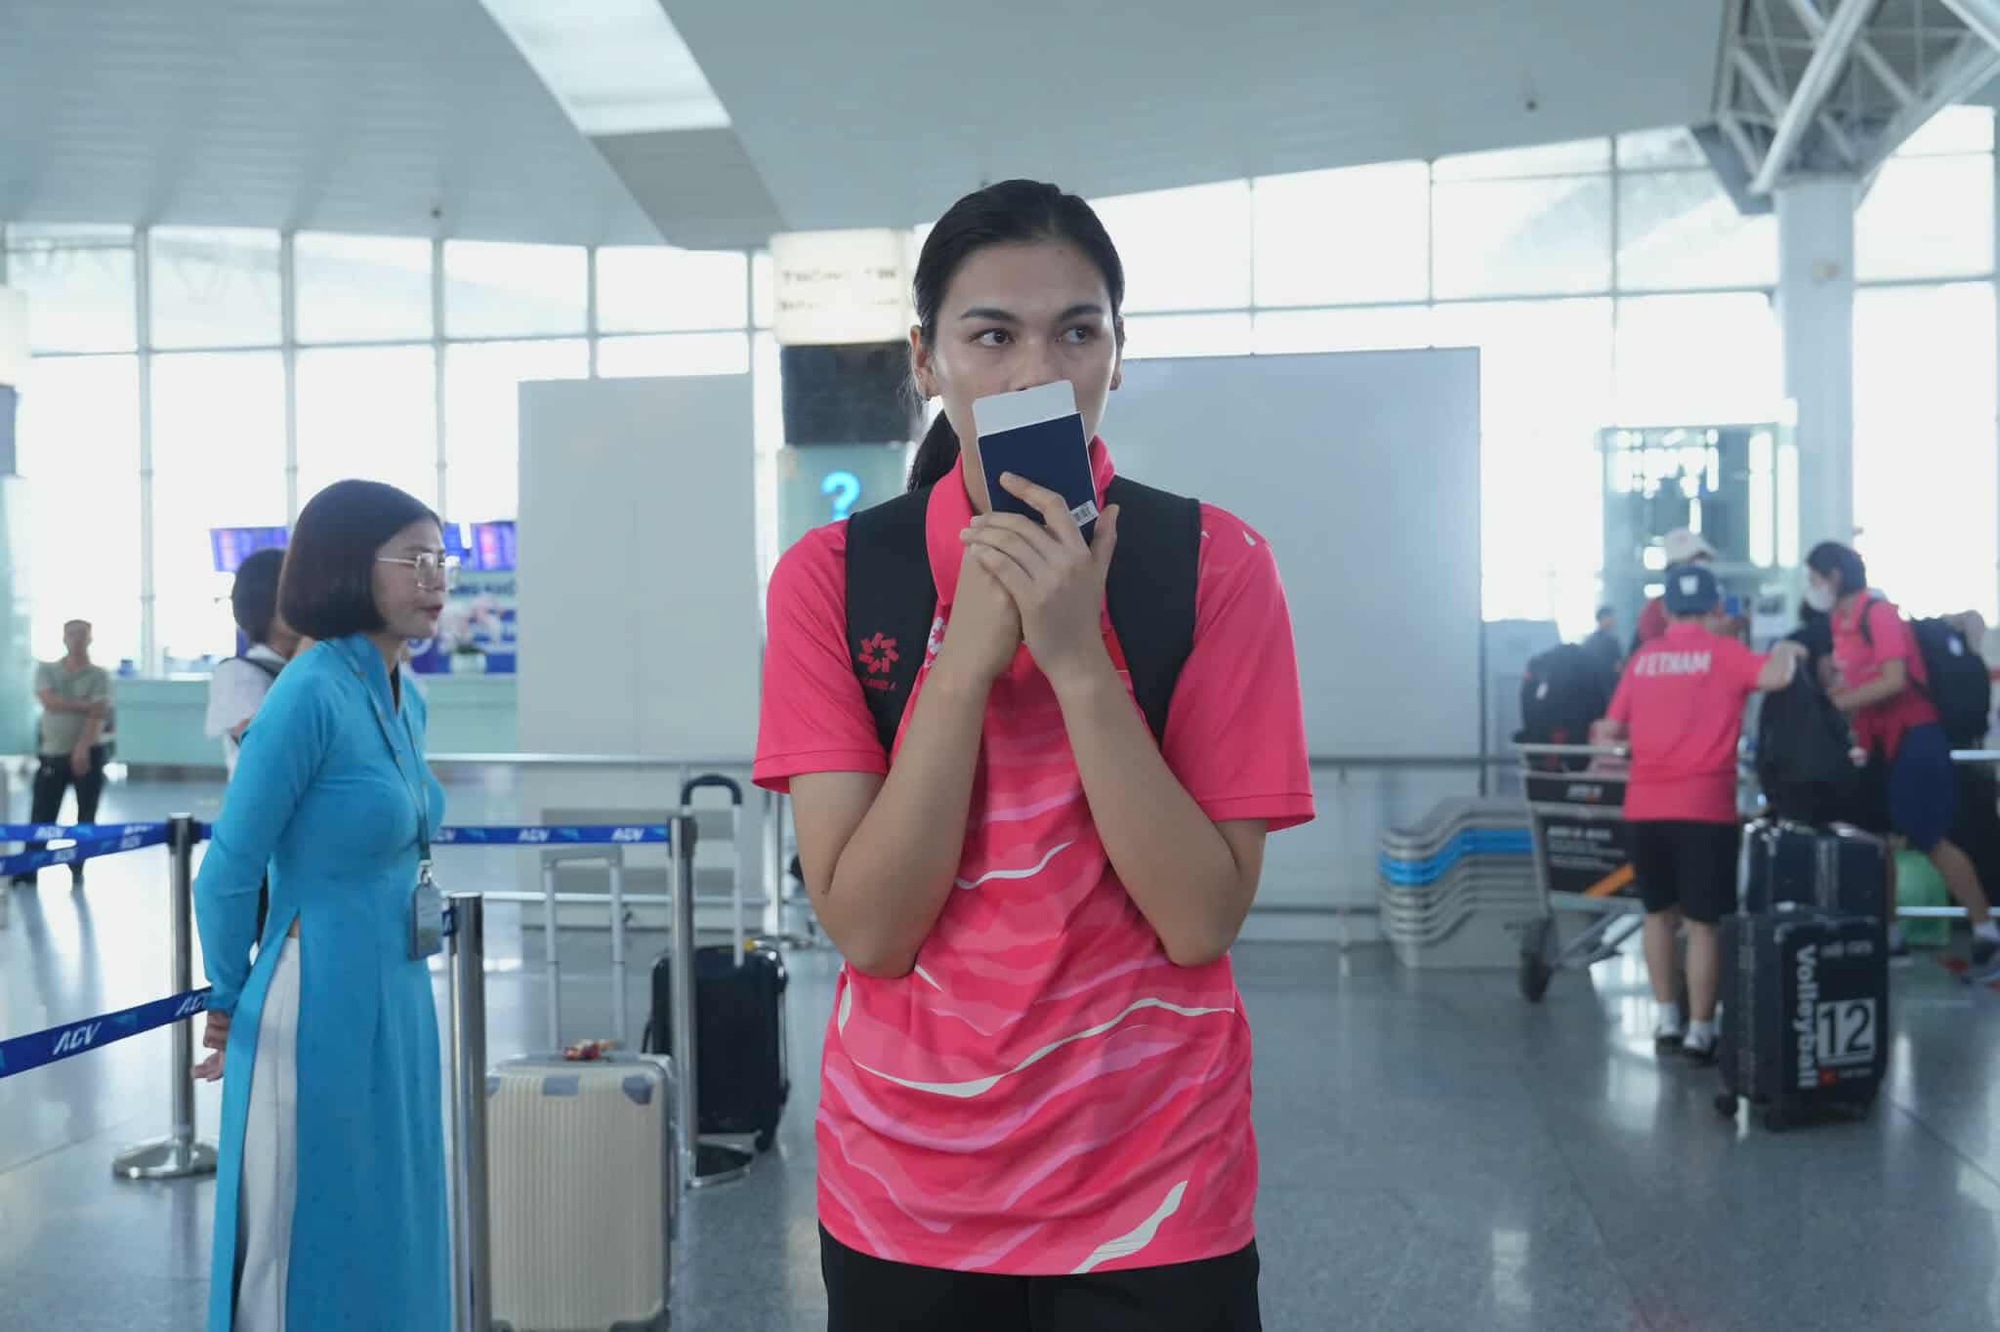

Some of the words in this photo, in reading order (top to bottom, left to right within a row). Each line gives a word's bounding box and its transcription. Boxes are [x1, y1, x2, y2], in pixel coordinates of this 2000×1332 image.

[1634, 650, 1711, 677] IETNAM
[517, 828, 550, 842] ACV
[611, 828, 646, 842] ACV
[53, 1021, 102, 1056] ACV
[174, 993, 206, 1017] AC
[1820, 1004, 1871, 1057] 12
